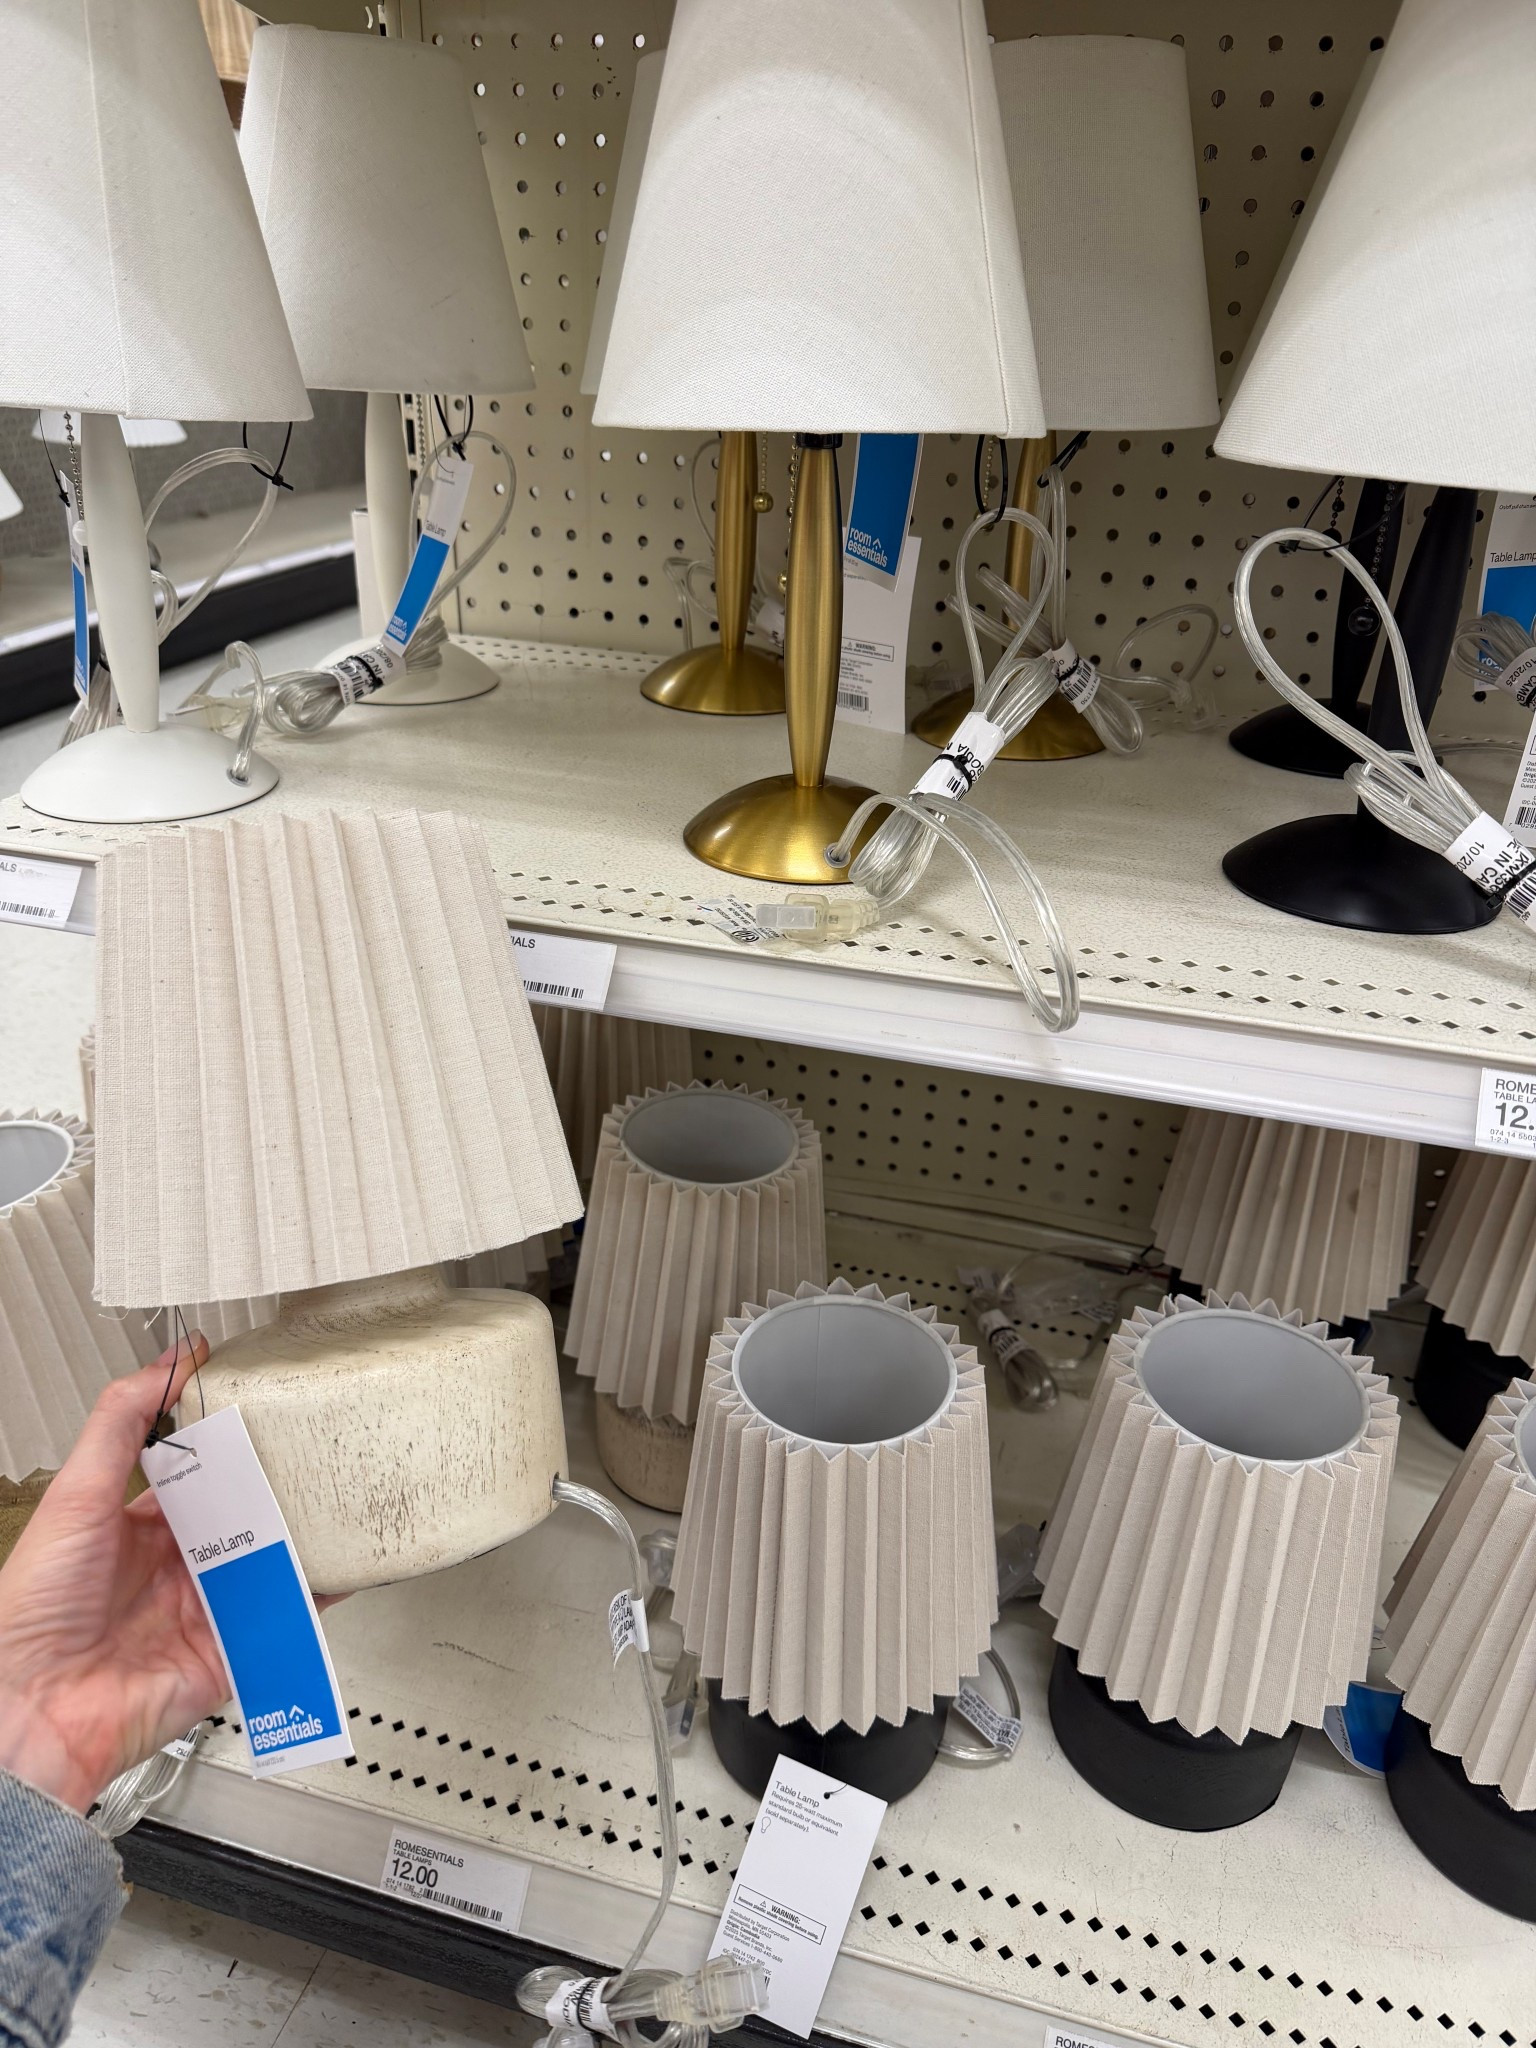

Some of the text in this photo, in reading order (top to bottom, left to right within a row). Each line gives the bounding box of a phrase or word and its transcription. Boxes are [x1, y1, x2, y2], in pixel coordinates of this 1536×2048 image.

[849, 527, 872, 547] room
[848, 540, 888, 568] essentials
[1490, 552, 1512, 562] Table
[1506, 658, 1536, 688] 10/2025
[1494, 850, 1513, 868] IN
[1494, 1090, 1524, 1103] TABLE
[1495, 1102, 1535, 1131] 12.
[1490, 1136, 1509, 1144] 1-2-3
[156, 1462, 202, 1488] Inline toggle switch
[188, 1530, 255, 1564] Table Lamp
[249, 1708, 287, 1734] room
[253, 1714, 324, 1750] essentials
[775, 1781, 820, 1808] Table Lamp
[765, 1808, 779, 1818] (sold
[768, 1800, 792, 1815] standard
[792, 1808, 805, 1821] bulb
[811, 1820, 839, 1836] equivalent
[772, 1790, 795, 1806] Requires
[816, 1812, 843, 1828] maximum
[393, 1849, 432, 1866] TABLE LAMPS
[394, 1839, 464, 1868] ROMESENTIALS
[392, 1858, 438, 1887] 12.00
[730, 1909, 750, 1922] Distributed
[756, 1921, 768, 1931] Target
[768, 1928, 790, 1941] Corporation
[738, 1896, 753, 1907] Remove
[753, 1904, 766, 1913] plastic
[778, 1916, 795, 1928] covering
[795, 1923, 807, 1933] before
[771, 1905, 800, 1924] WARNING:
[723, 1930, 734, 1939] Guest
[734, 1936, 750, 1947] Services
[726, 1920, 760, 1939] Origin: Cambodia
[740, 1932, 751, 1941] Target
[759, 1930, 771, 1939] 55403
